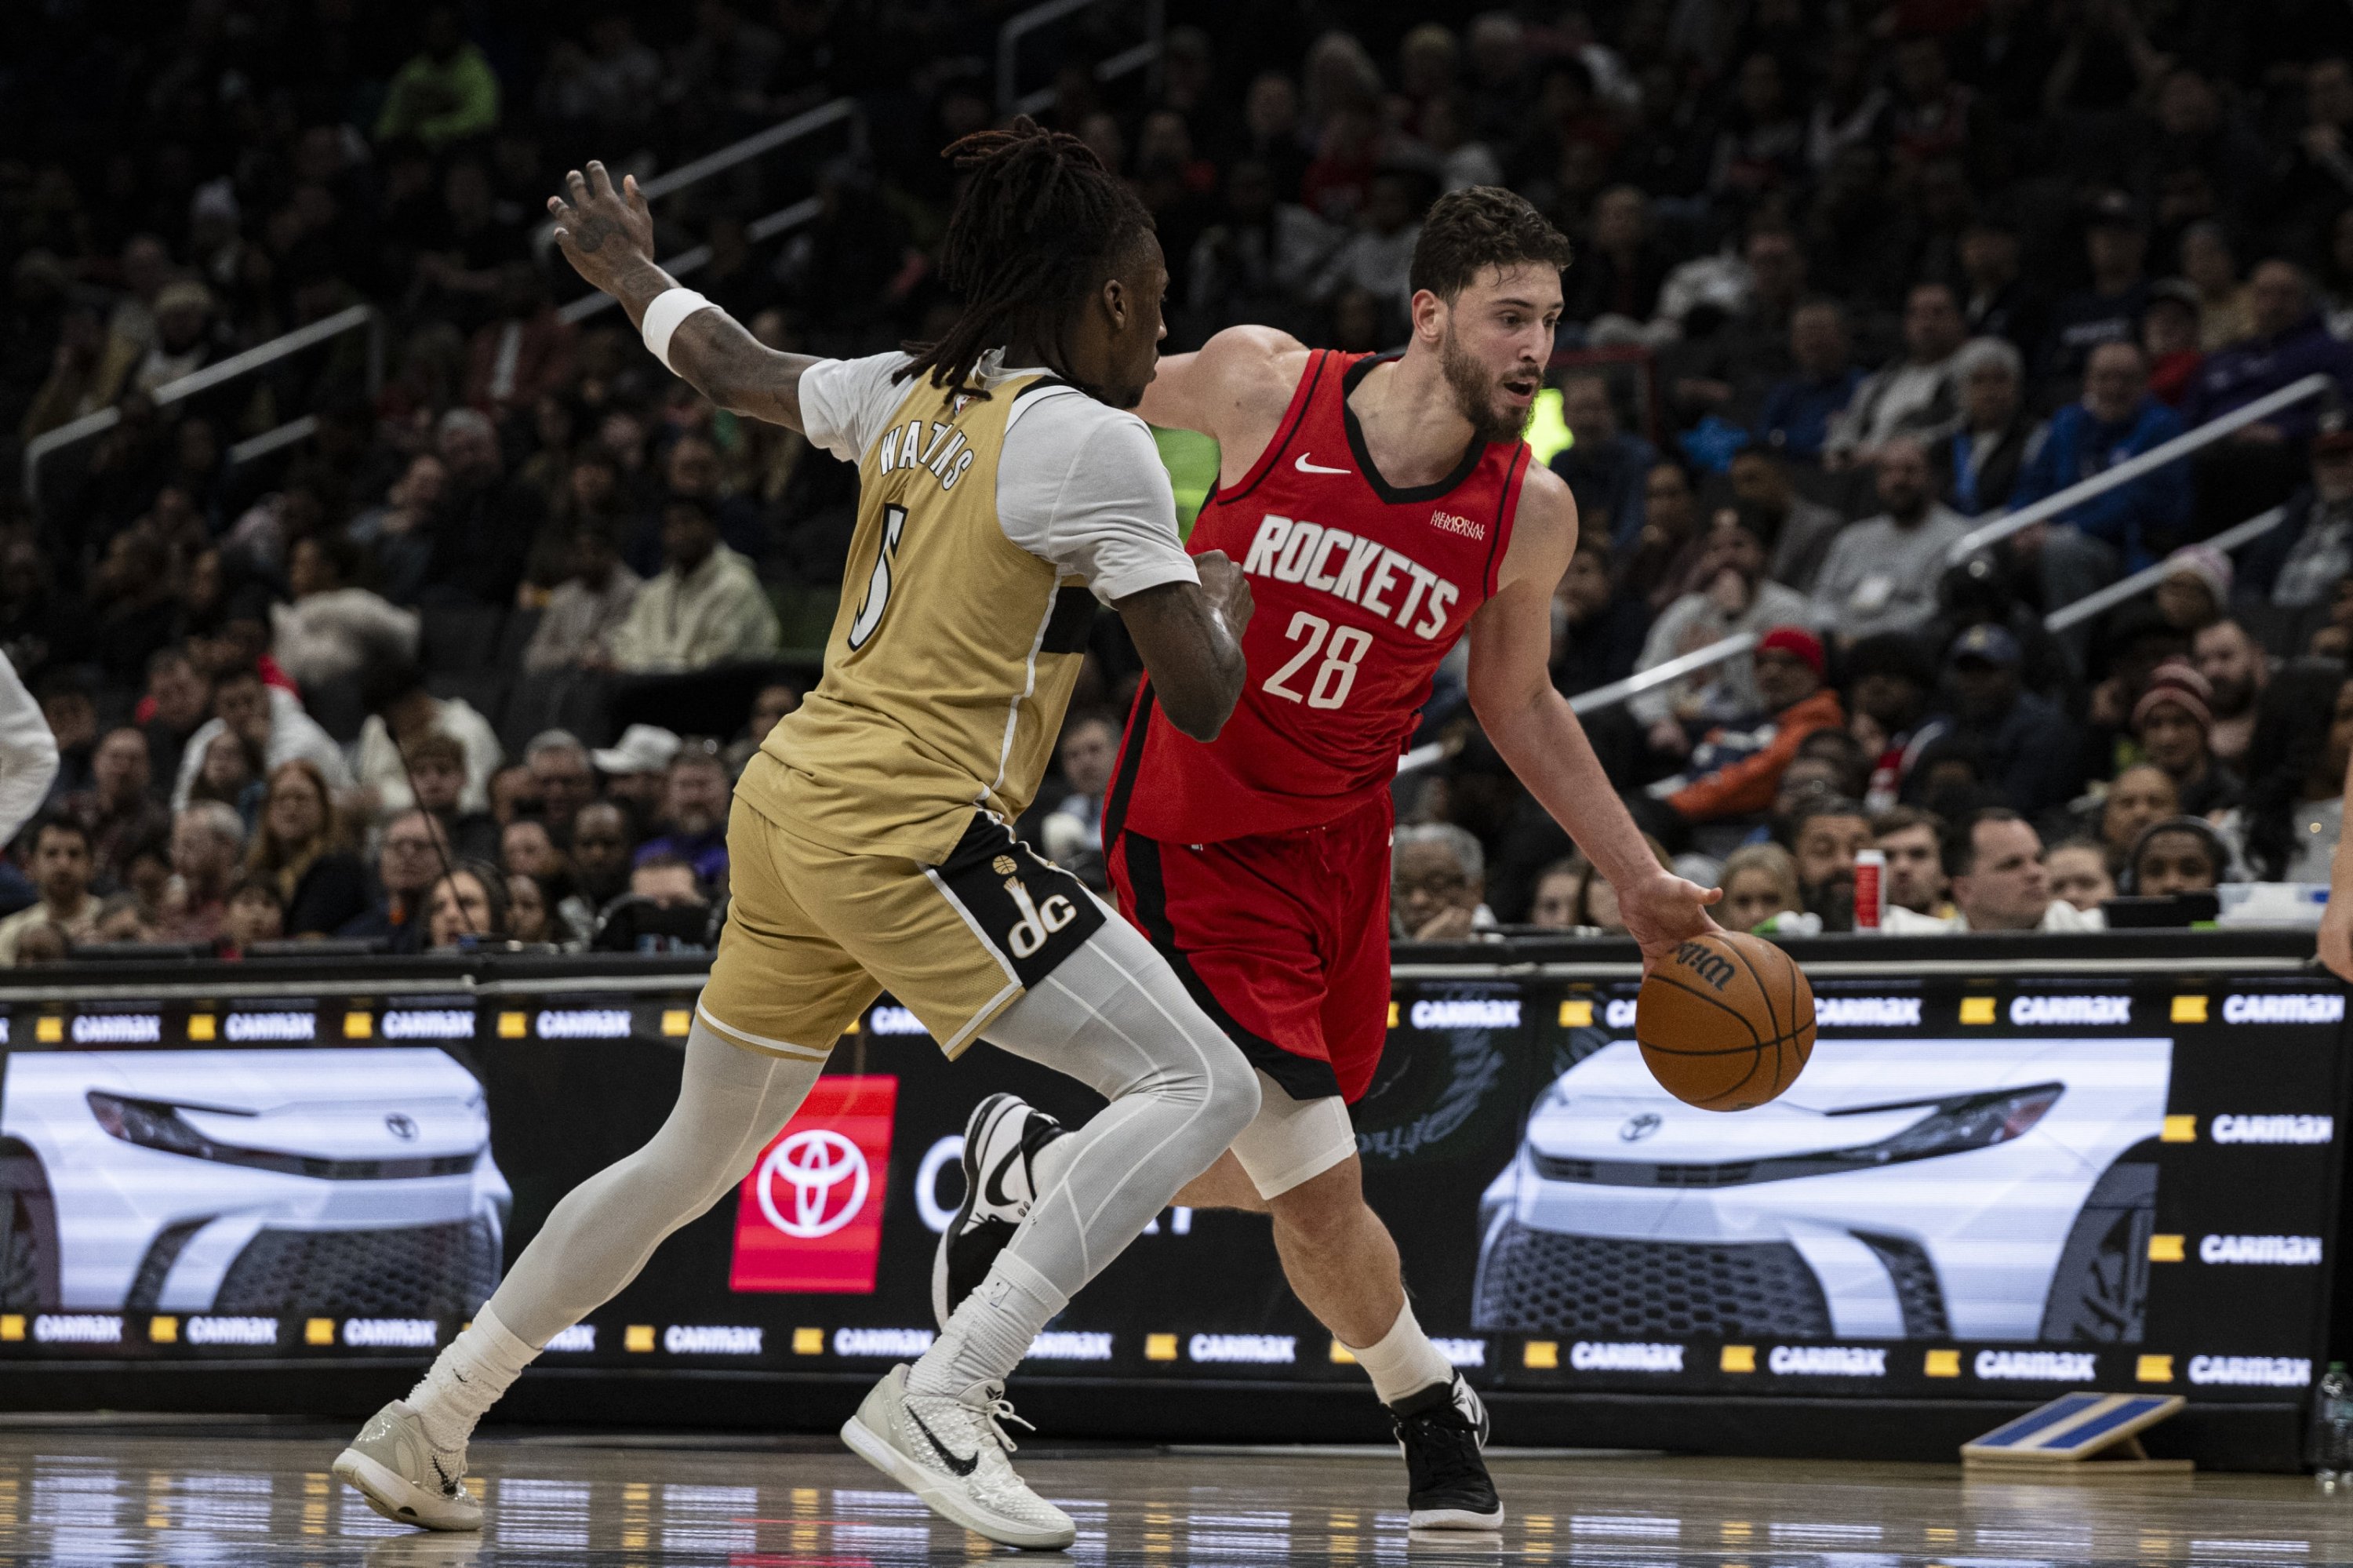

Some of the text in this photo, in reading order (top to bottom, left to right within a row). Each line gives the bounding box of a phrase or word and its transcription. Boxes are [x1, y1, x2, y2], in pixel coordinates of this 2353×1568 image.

[1430, 517, 1485, 541] HERMANN
[1432, 510, 1486, 534] MEMORIAL
[1243, 514, 1460, 641] ROCKETS
[1261, 610, 1373, 710] 28
